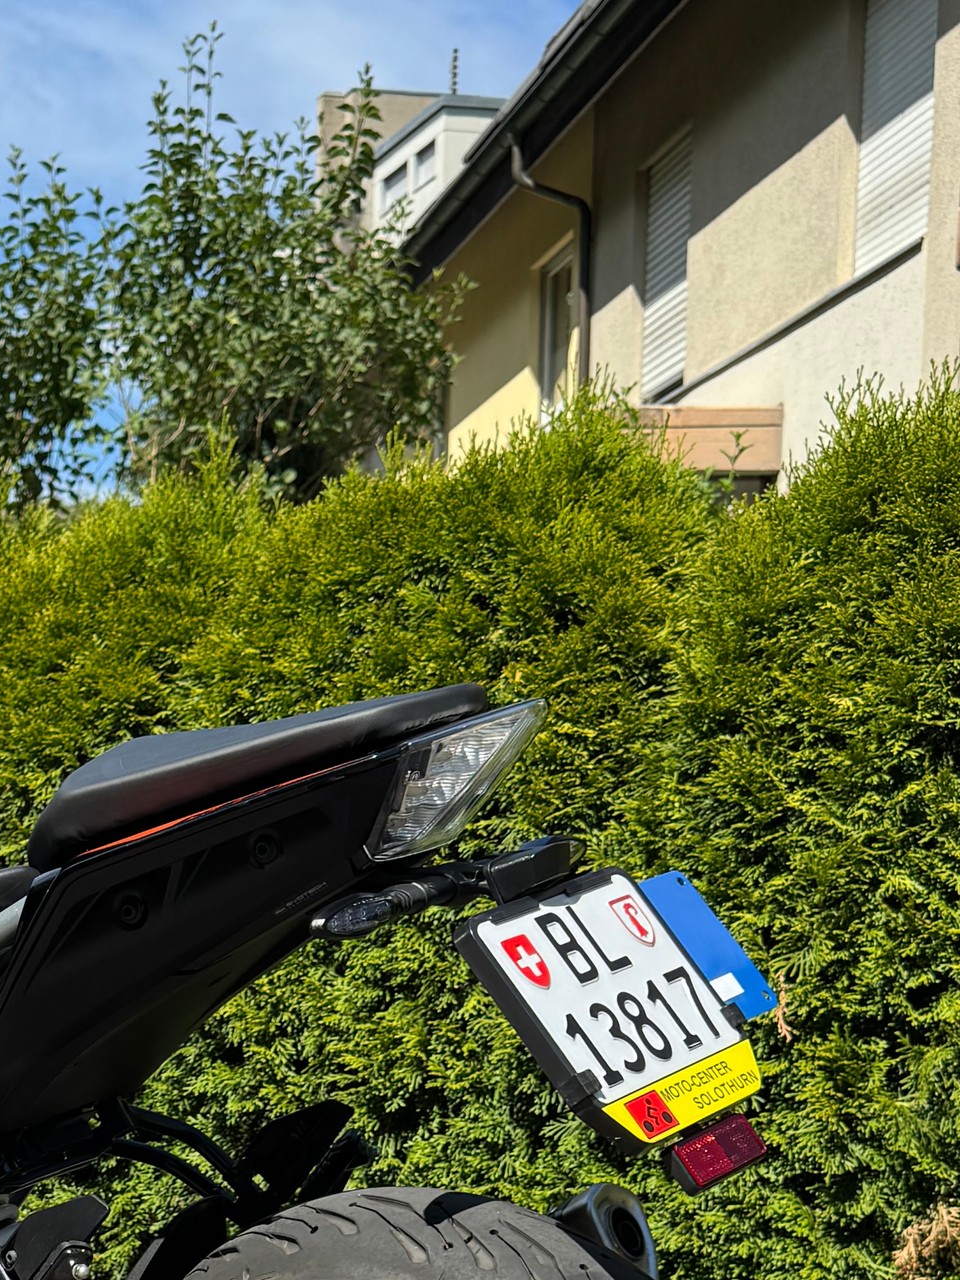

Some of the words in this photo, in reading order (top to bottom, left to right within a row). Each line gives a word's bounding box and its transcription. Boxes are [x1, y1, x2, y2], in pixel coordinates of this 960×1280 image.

[534, 905, 634, 987] BL
[565, 965, 721, 1088] 13817
[660, 1060, 733, 1103] MOTO-CENTER
[693, 1071, 760, 1111] SOLOTHURN
